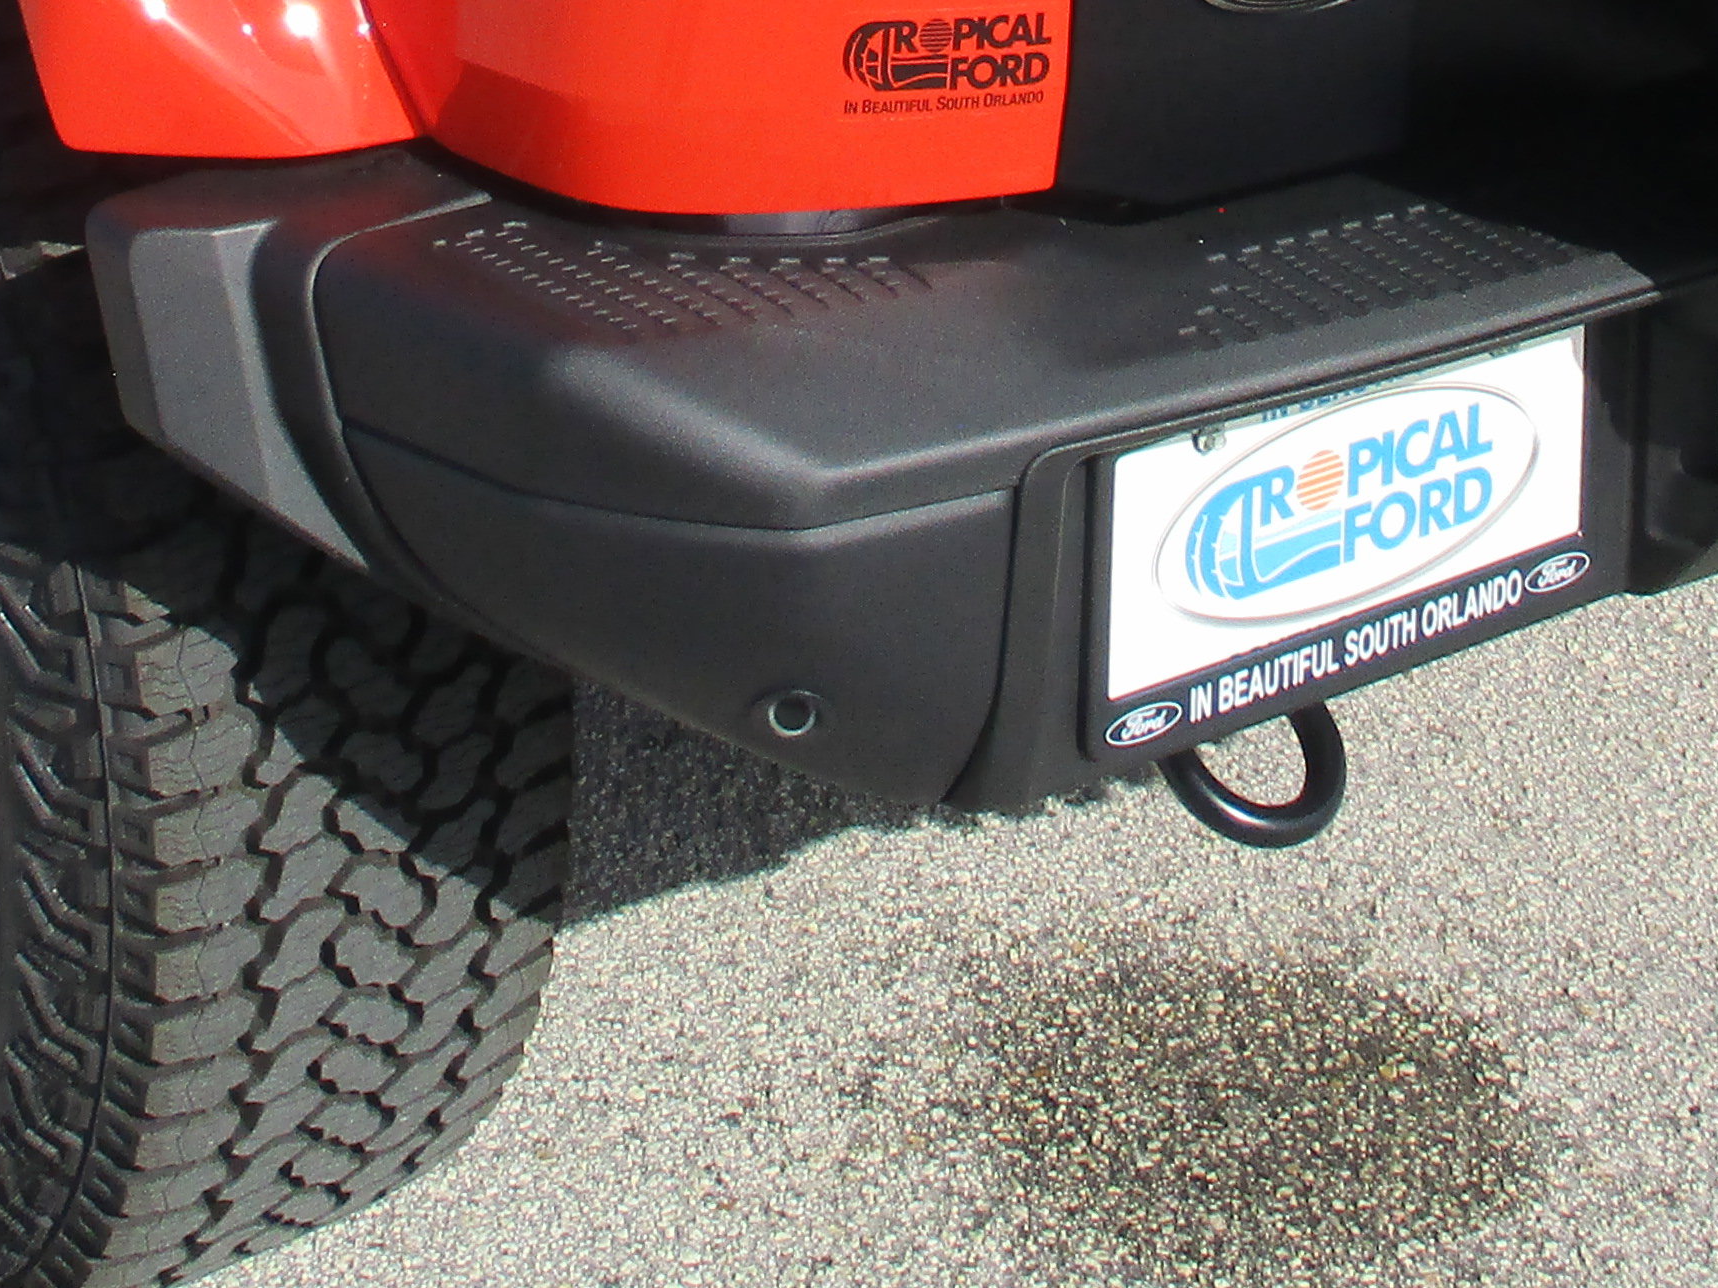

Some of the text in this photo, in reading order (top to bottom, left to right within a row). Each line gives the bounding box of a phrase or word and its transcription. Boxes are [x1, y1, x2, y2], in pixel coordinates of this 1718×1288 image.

[844, 90, 1044, 114] IN BEAUTIFUL SOUTH ORLANDO
[949, 52, 1050, 91] FORD
[1343, 466, 1493, 563] FORD
[1119, 556, 1580, 741] Ford IN BEAUTIFUL SOUTH ORLANDO Ford
